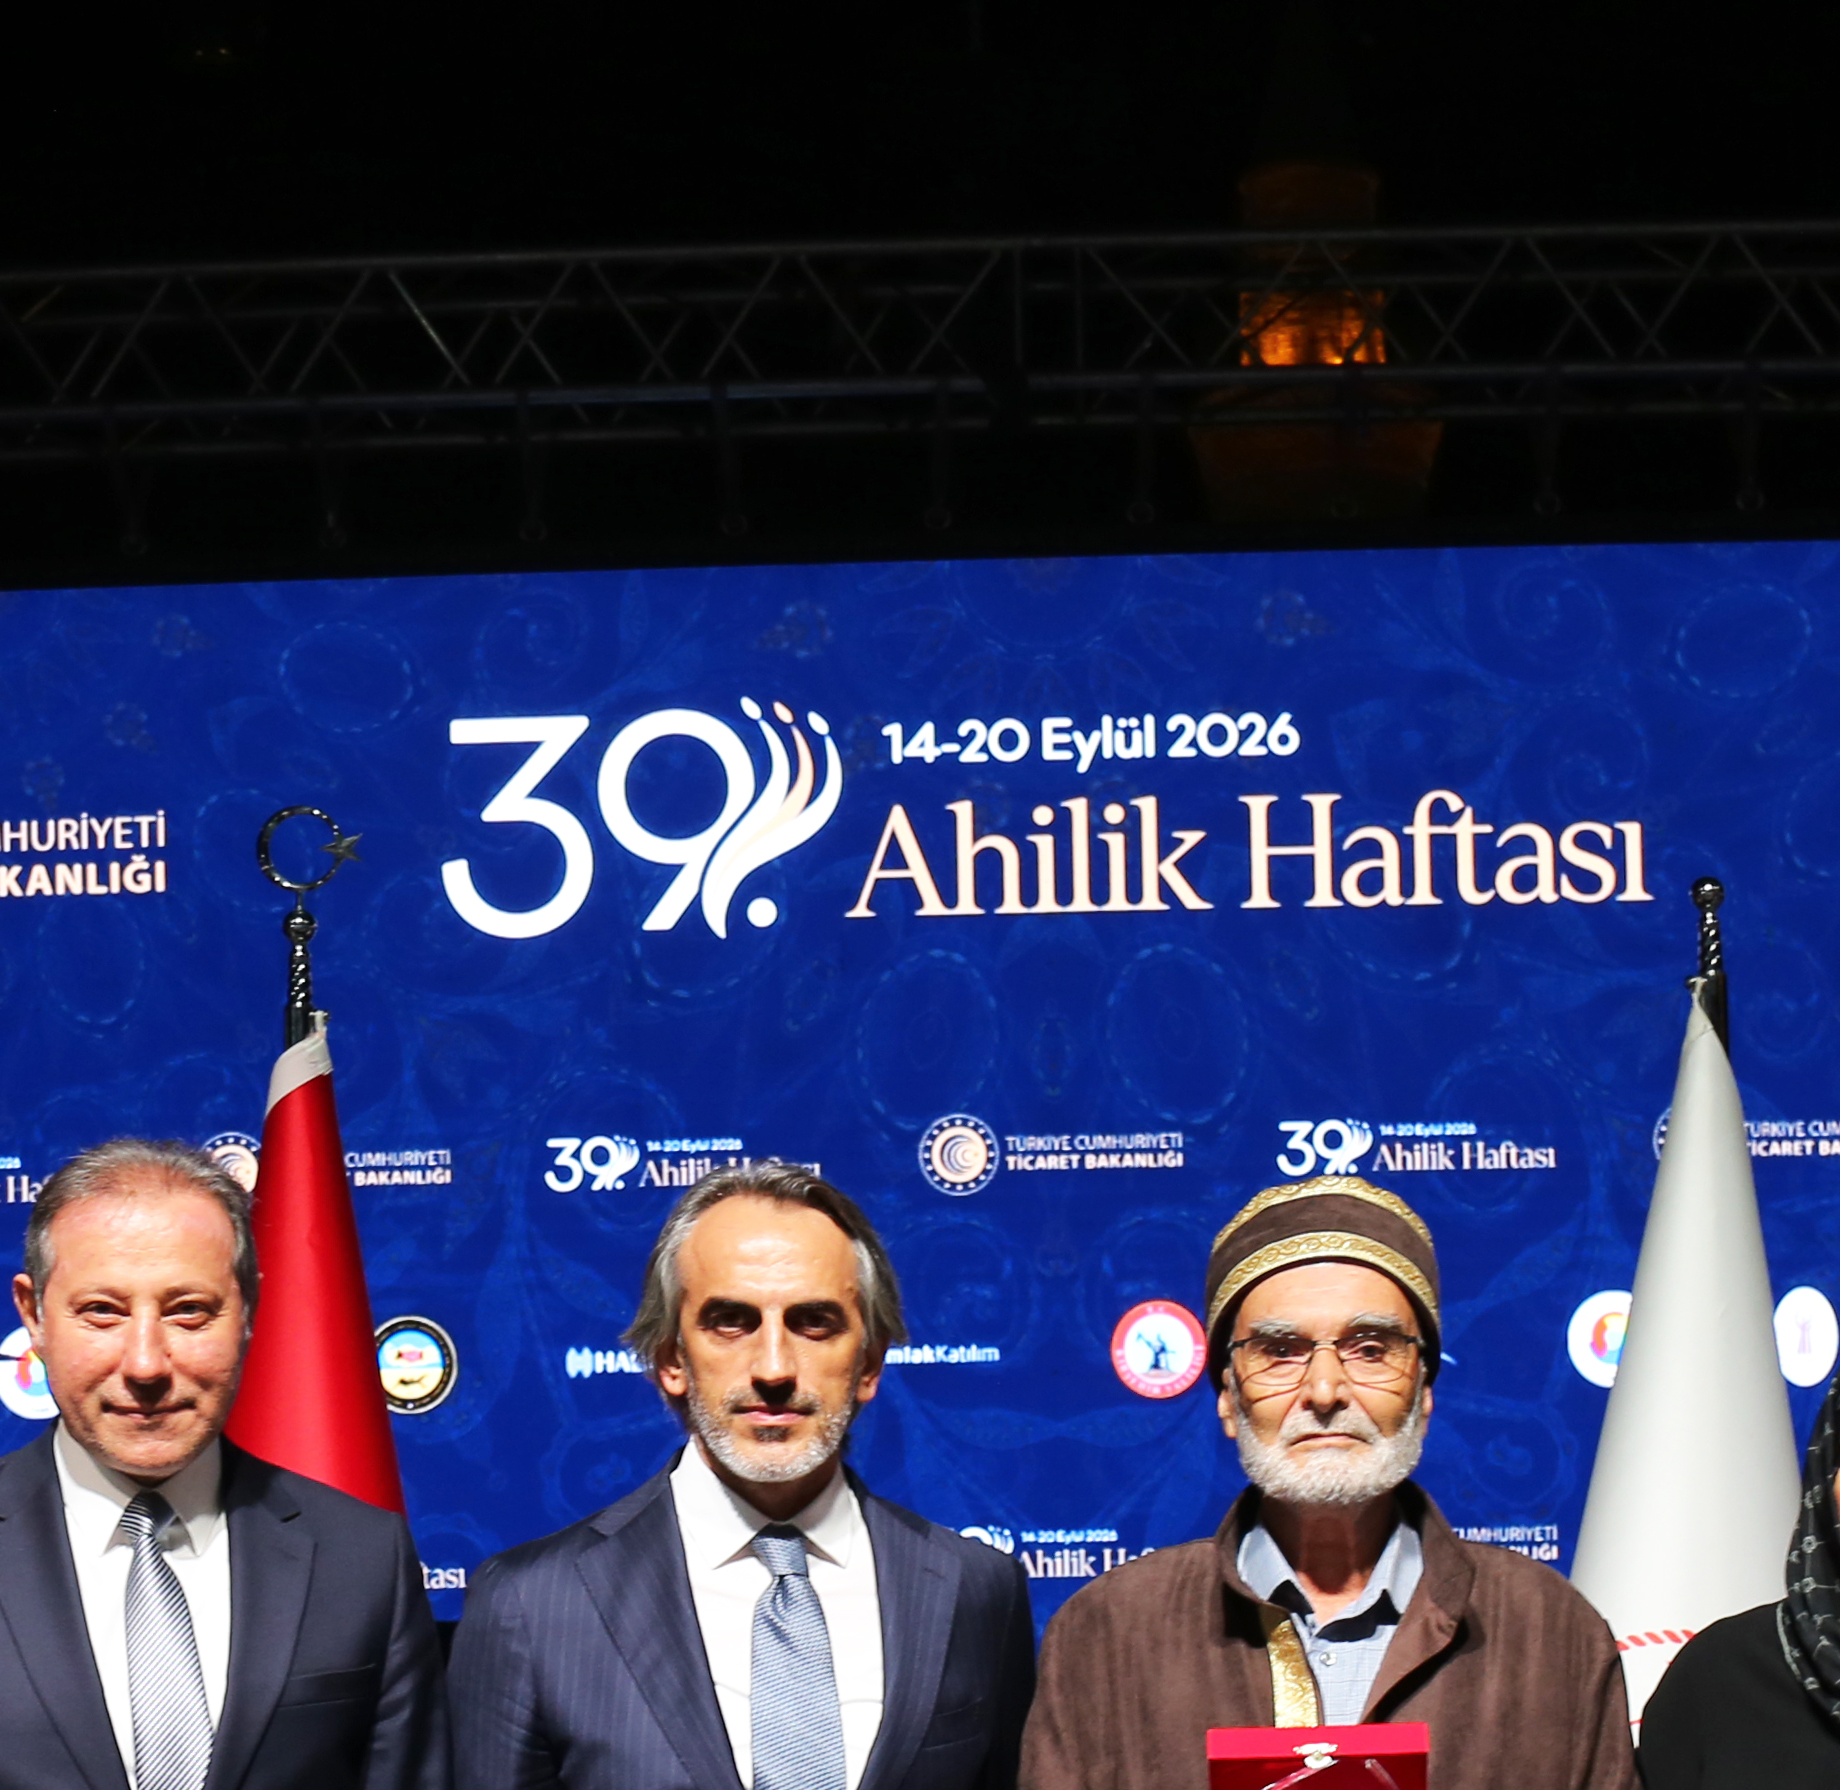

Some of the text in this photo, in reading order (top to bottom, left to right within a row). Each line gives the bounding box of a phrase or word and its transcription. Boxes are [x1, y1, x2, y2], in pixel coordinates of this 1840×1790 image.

[881, 711, 1302, 775] 14-20 Eylül 2026
[845, 788, 1656, 918] Ahilik Haftası
[1084, 1150, 1184, 1170] BAKANLIĞI
[1372, 1140, 1558, 1172] Ahilik Haftası
[1746, 1138, 1816, 1157] İCARET
[354, 1167, 452, 1187] BAKANLIĞI
[884, 1343, 1001, 1365] mlakKatılım
[420, 1561, 467, 1590] tası
[1019, 1548, 1098, 1578] Ahilik
